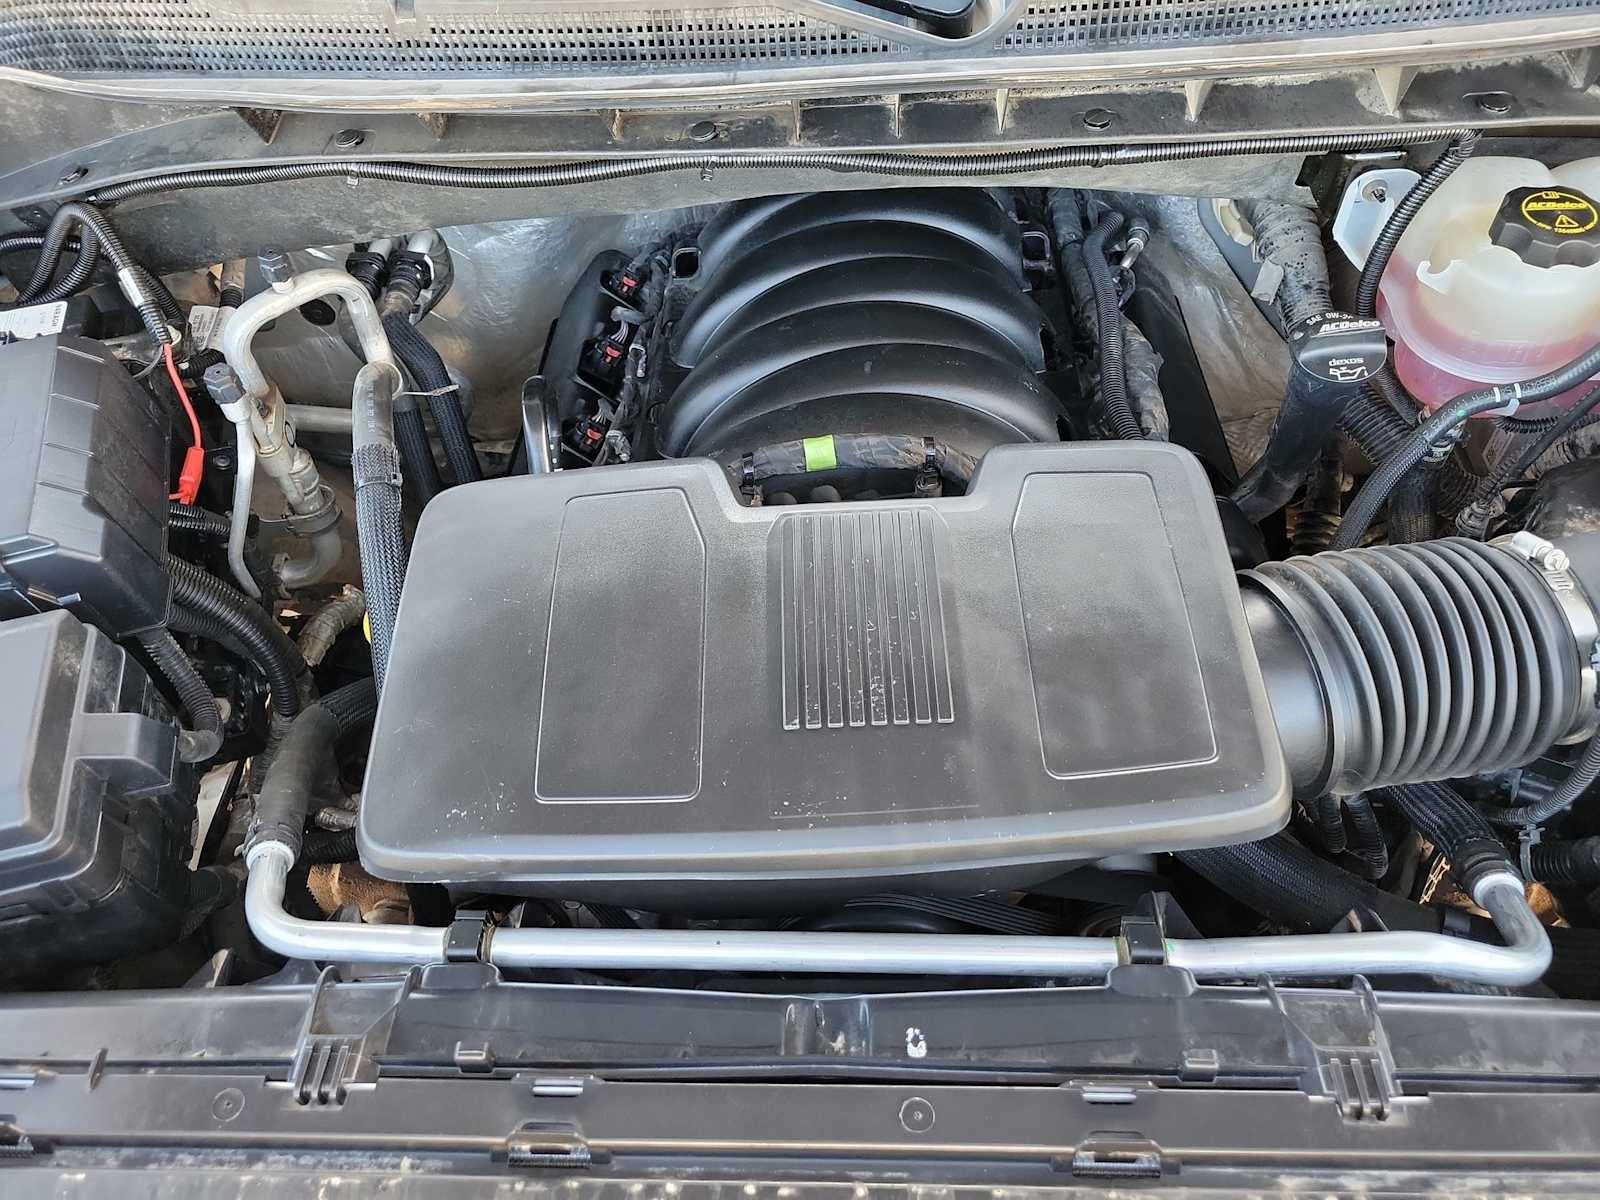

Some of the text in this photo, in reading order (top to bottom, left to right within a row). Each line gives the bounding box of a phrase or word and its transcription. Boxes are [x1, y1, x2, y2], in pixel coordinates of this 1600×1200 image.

[1526, 201, 1588, 209] ACDelco
[1306, 314, 1323, 326] SAE
[1319, 319, 1380, 333] ACDelco
[1328, 357, 1364, 367] dexos
